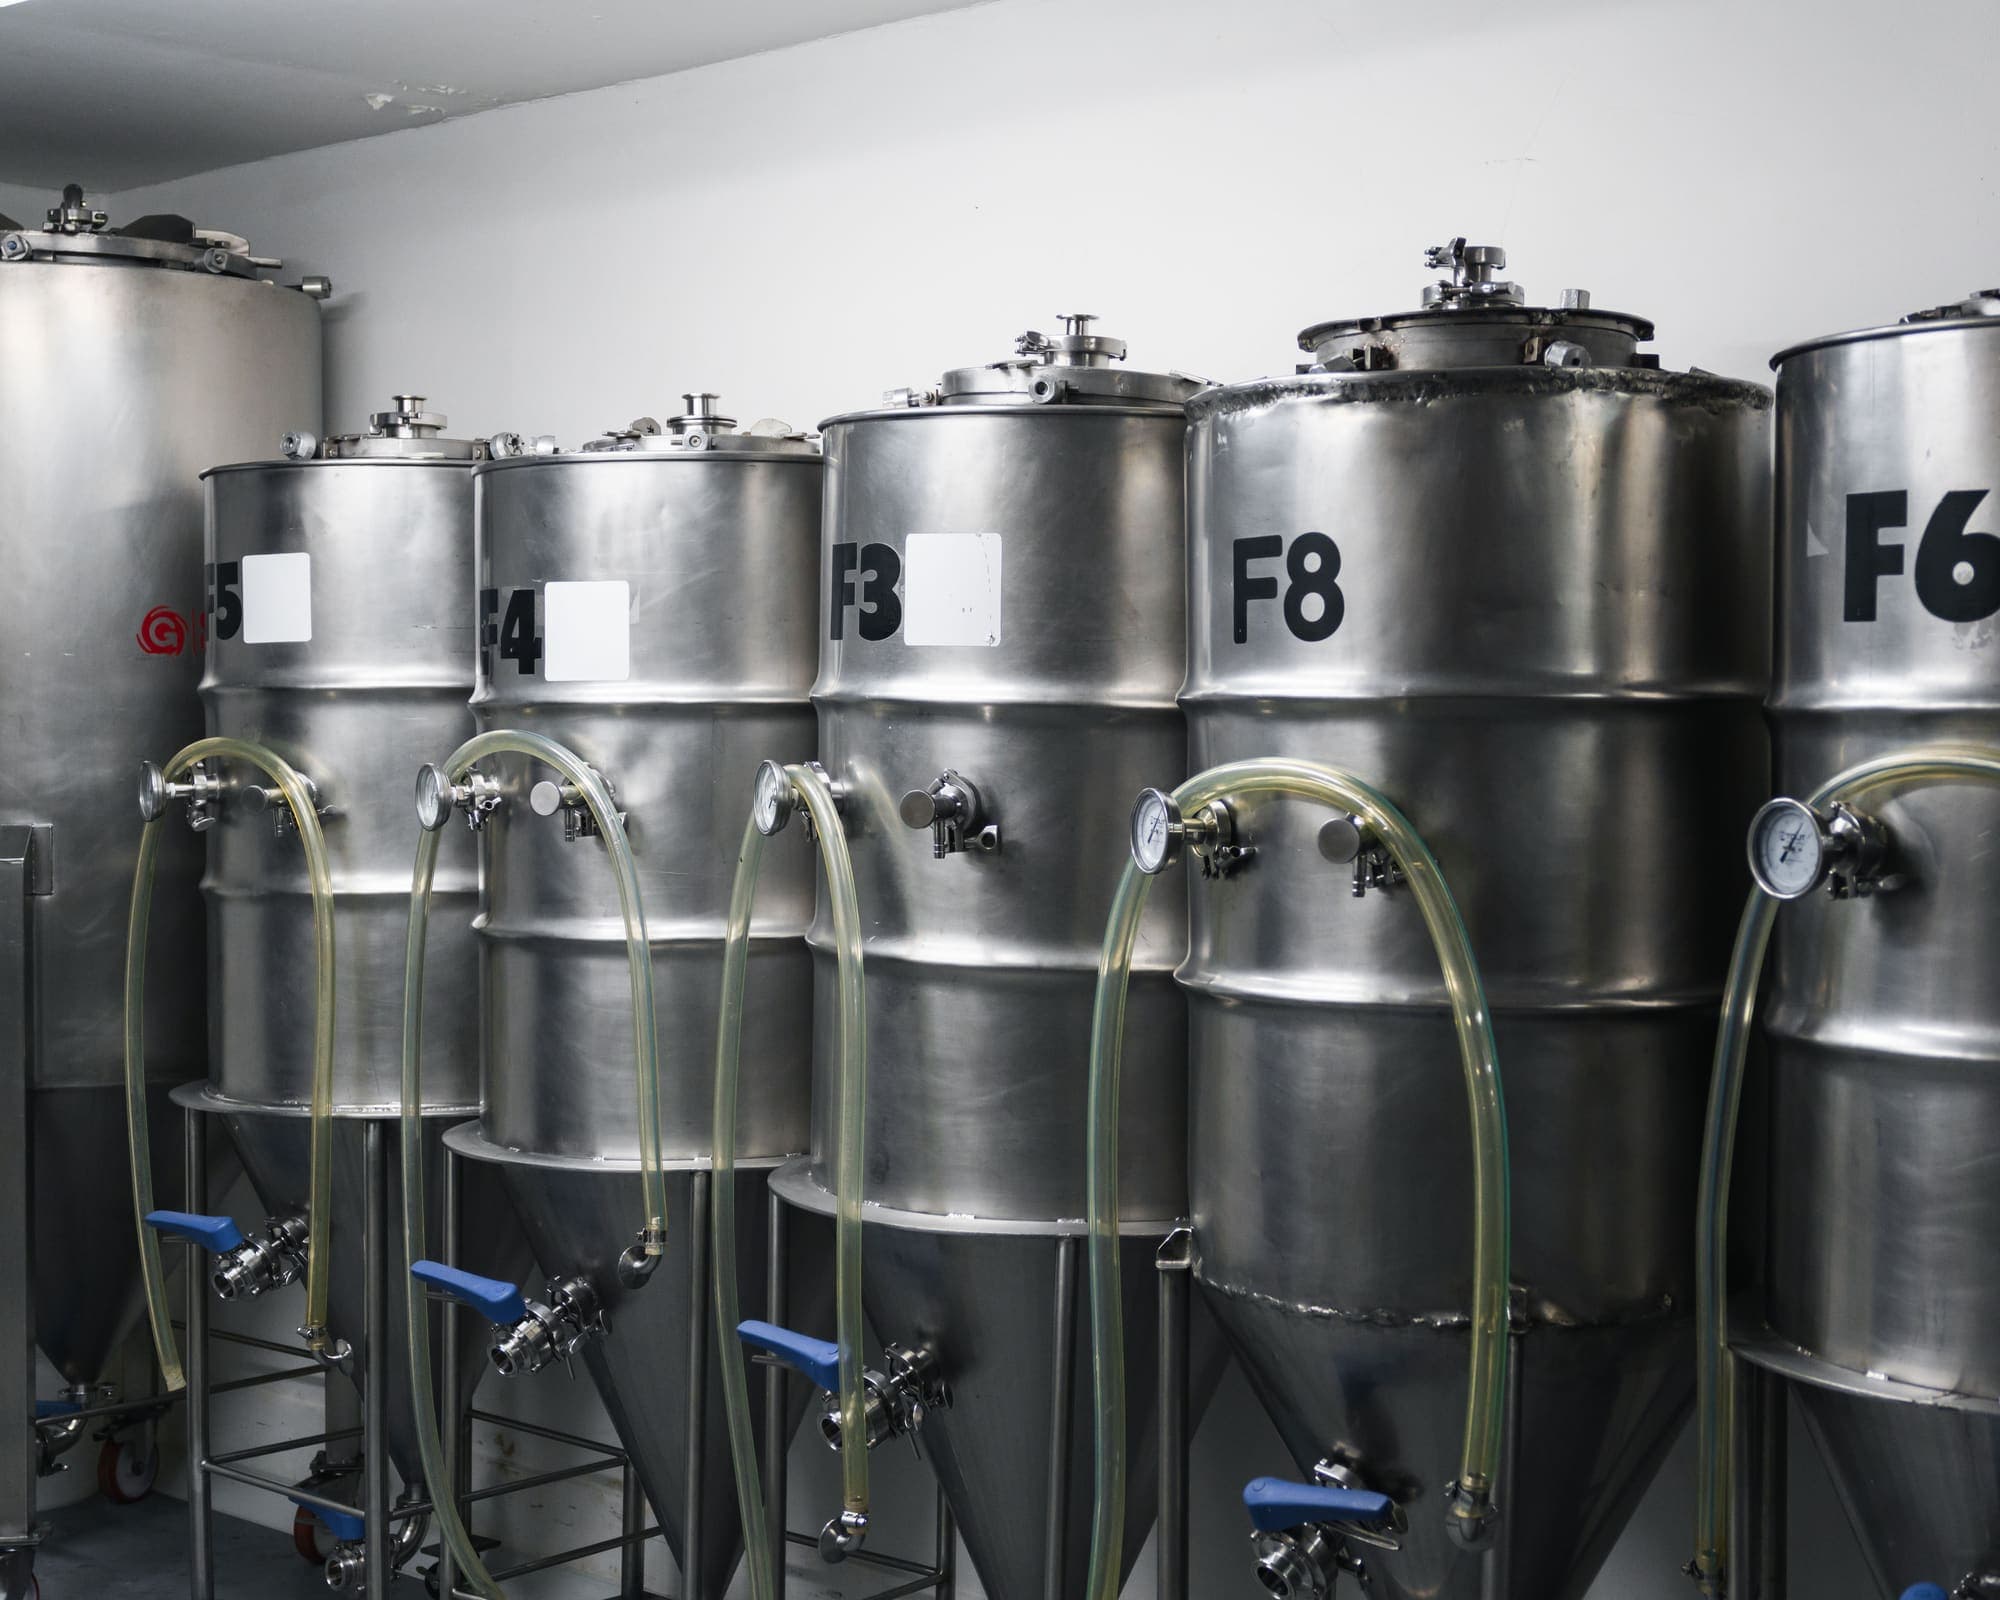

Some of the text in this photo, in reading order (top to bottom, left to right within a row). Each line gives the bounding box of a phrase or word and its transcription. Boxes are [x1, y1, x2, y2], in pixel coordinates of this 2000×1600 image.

[831, 541, 903, 642] F3
[1233, 531, 1345, 645] F8
[1843, 489, 2000, 624] F6
